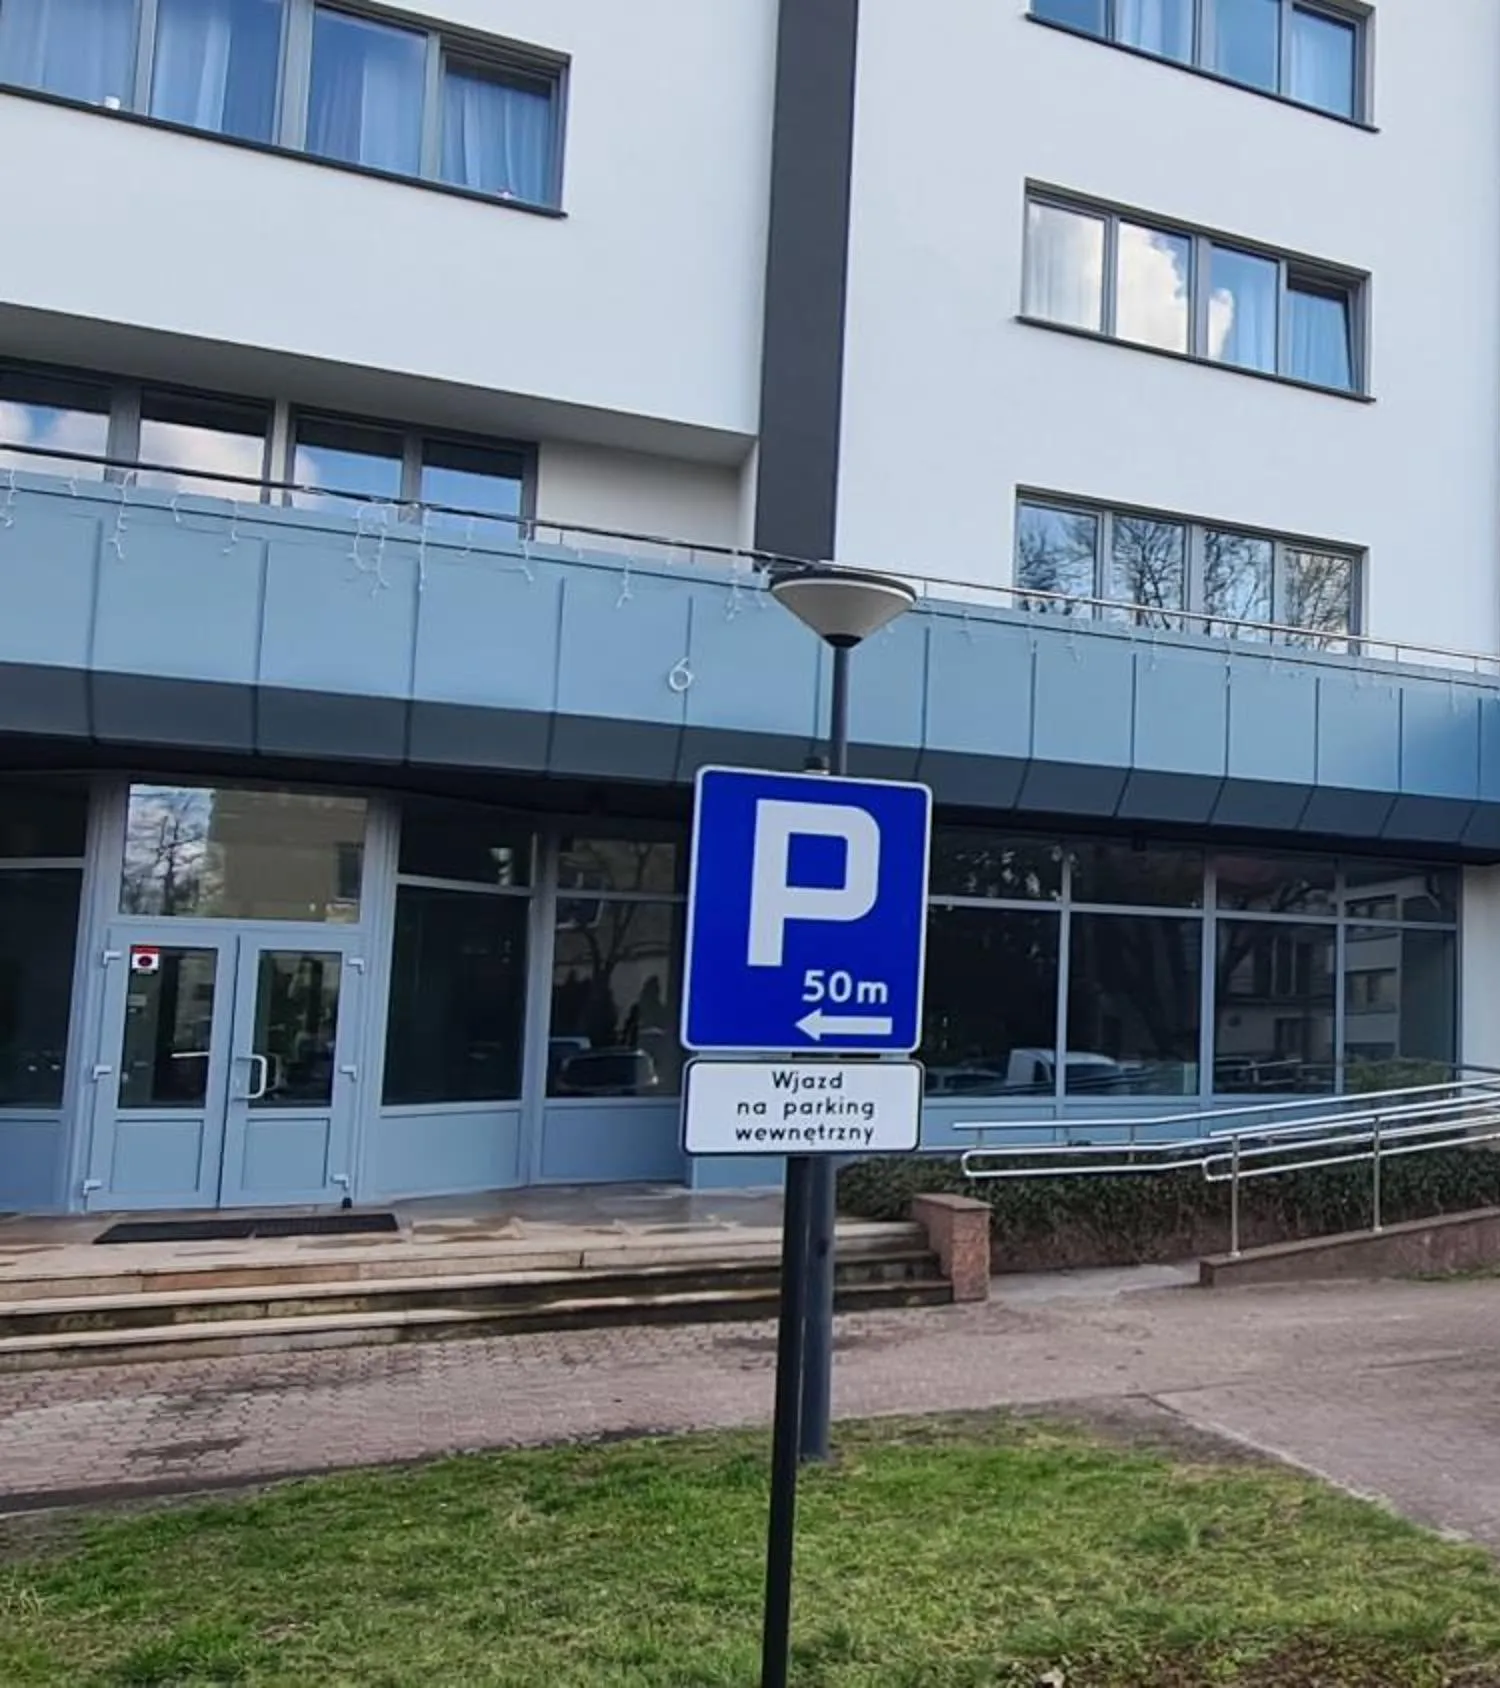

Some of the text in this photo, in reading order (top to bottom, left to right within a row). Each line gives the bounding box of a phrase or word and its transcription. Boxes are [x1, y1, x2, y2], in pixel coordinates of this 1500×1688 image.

[747, 799, 881, 967] P
[772, 1070, 843, 1094] Wjazd
[737, 1096, 875, 1121] na parking
[735, 1123, 874, 1146] wewnętrzny
